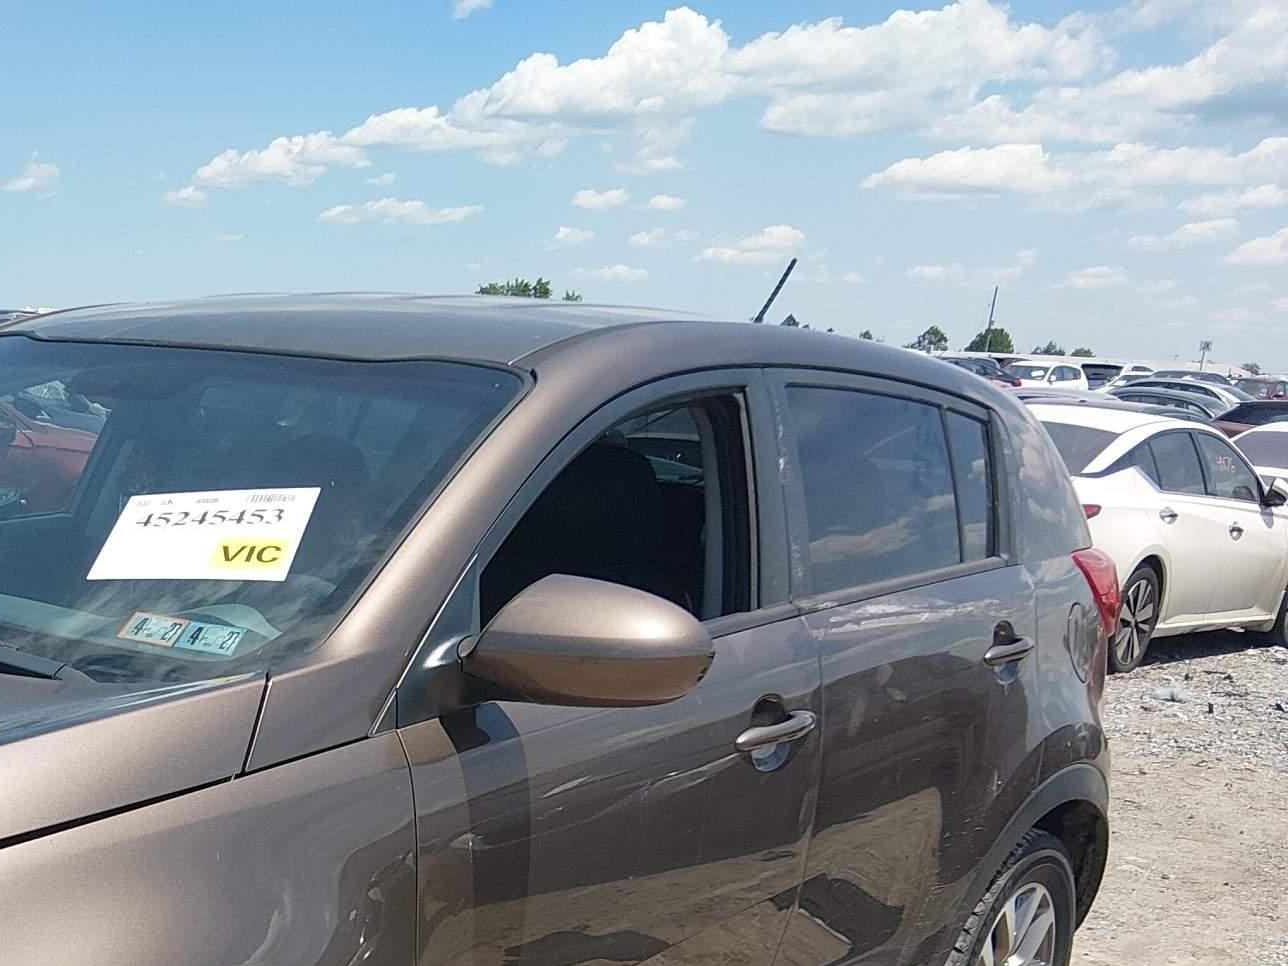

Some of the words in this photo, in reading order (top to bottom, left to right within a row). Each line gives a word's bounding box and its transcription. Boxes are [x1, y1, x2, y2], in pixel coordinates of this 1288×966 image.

[136, 508, 285, 527] 45245453
[221, 545, 281, 563] VIC
[133, 617, 149, 636] 4
[160, 622, 183, 642] 27
[189, 626, 204, 645] 4
[219, 630, 240, 651] 27
